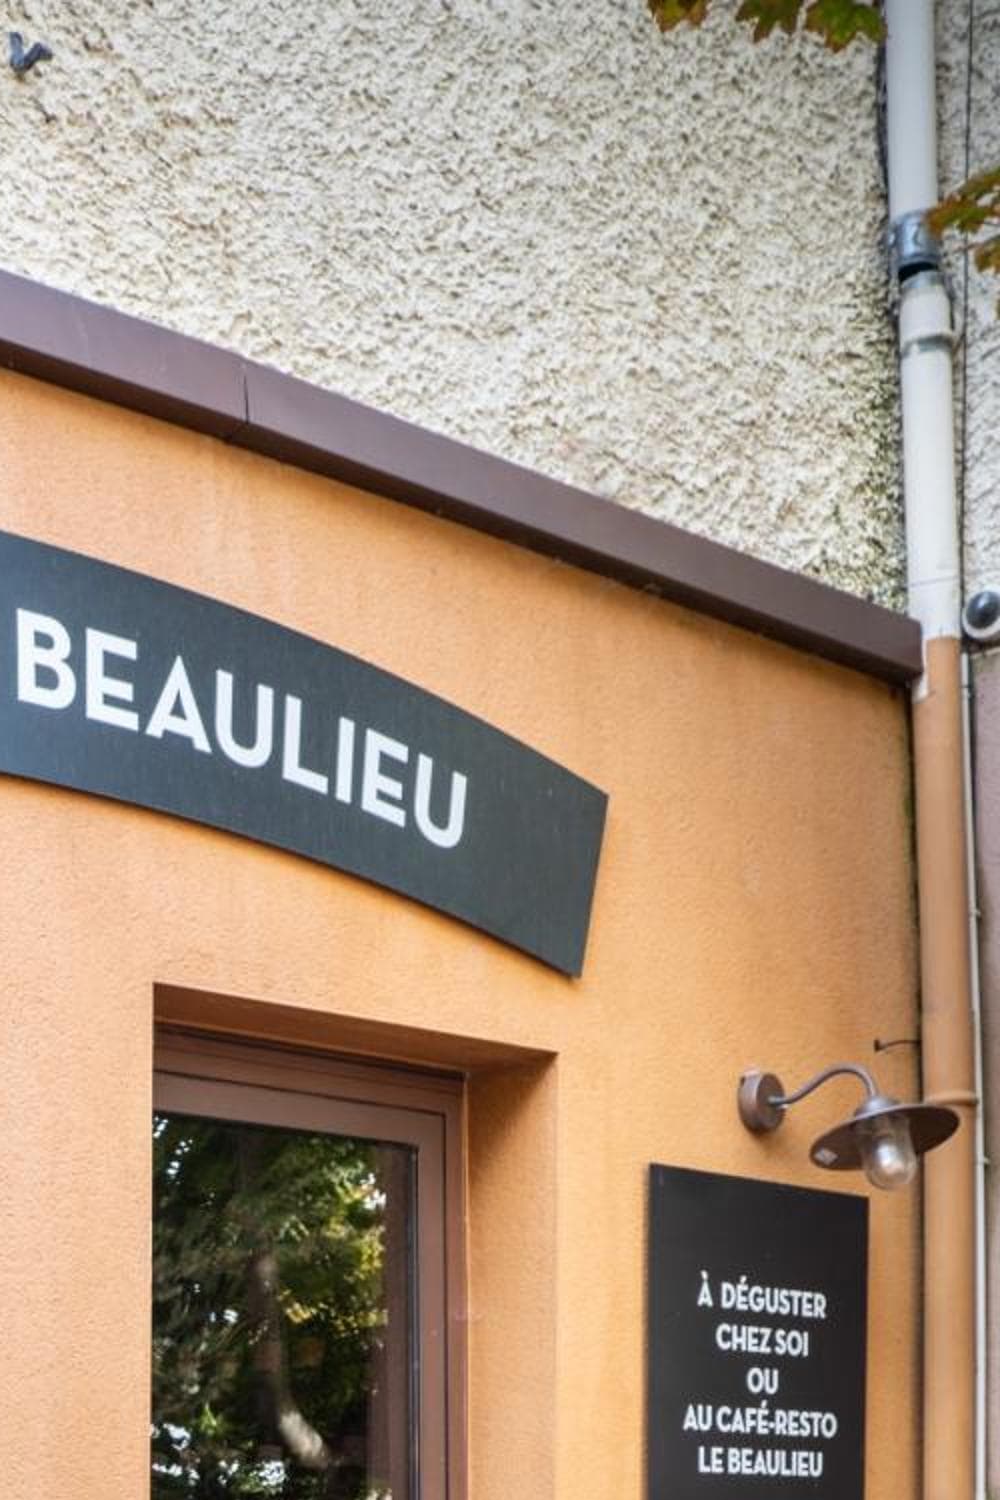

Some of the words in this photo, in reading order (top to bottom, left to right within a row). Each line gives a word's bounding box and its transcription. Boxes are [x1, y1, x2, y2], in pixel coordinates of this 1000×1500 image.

[16, 607, 467, 849] BEAULIEU
[697, 1270, 713, 1307] À
[720, 1275, 827, 1319] DÉGUSTER
[716, 1323, 771, 1354] CHEZ
[774, 1329, 809, 1357] SOI
[746, 1367, 779, 1394] OU
[683, 1404, 712, 1432] AU
[716, 1400, 838, 1438] CAFÉ-RESTO
[698, 1446, 724, 1474] LE
[727, 1448, 823, 1478] BEAULIEU
